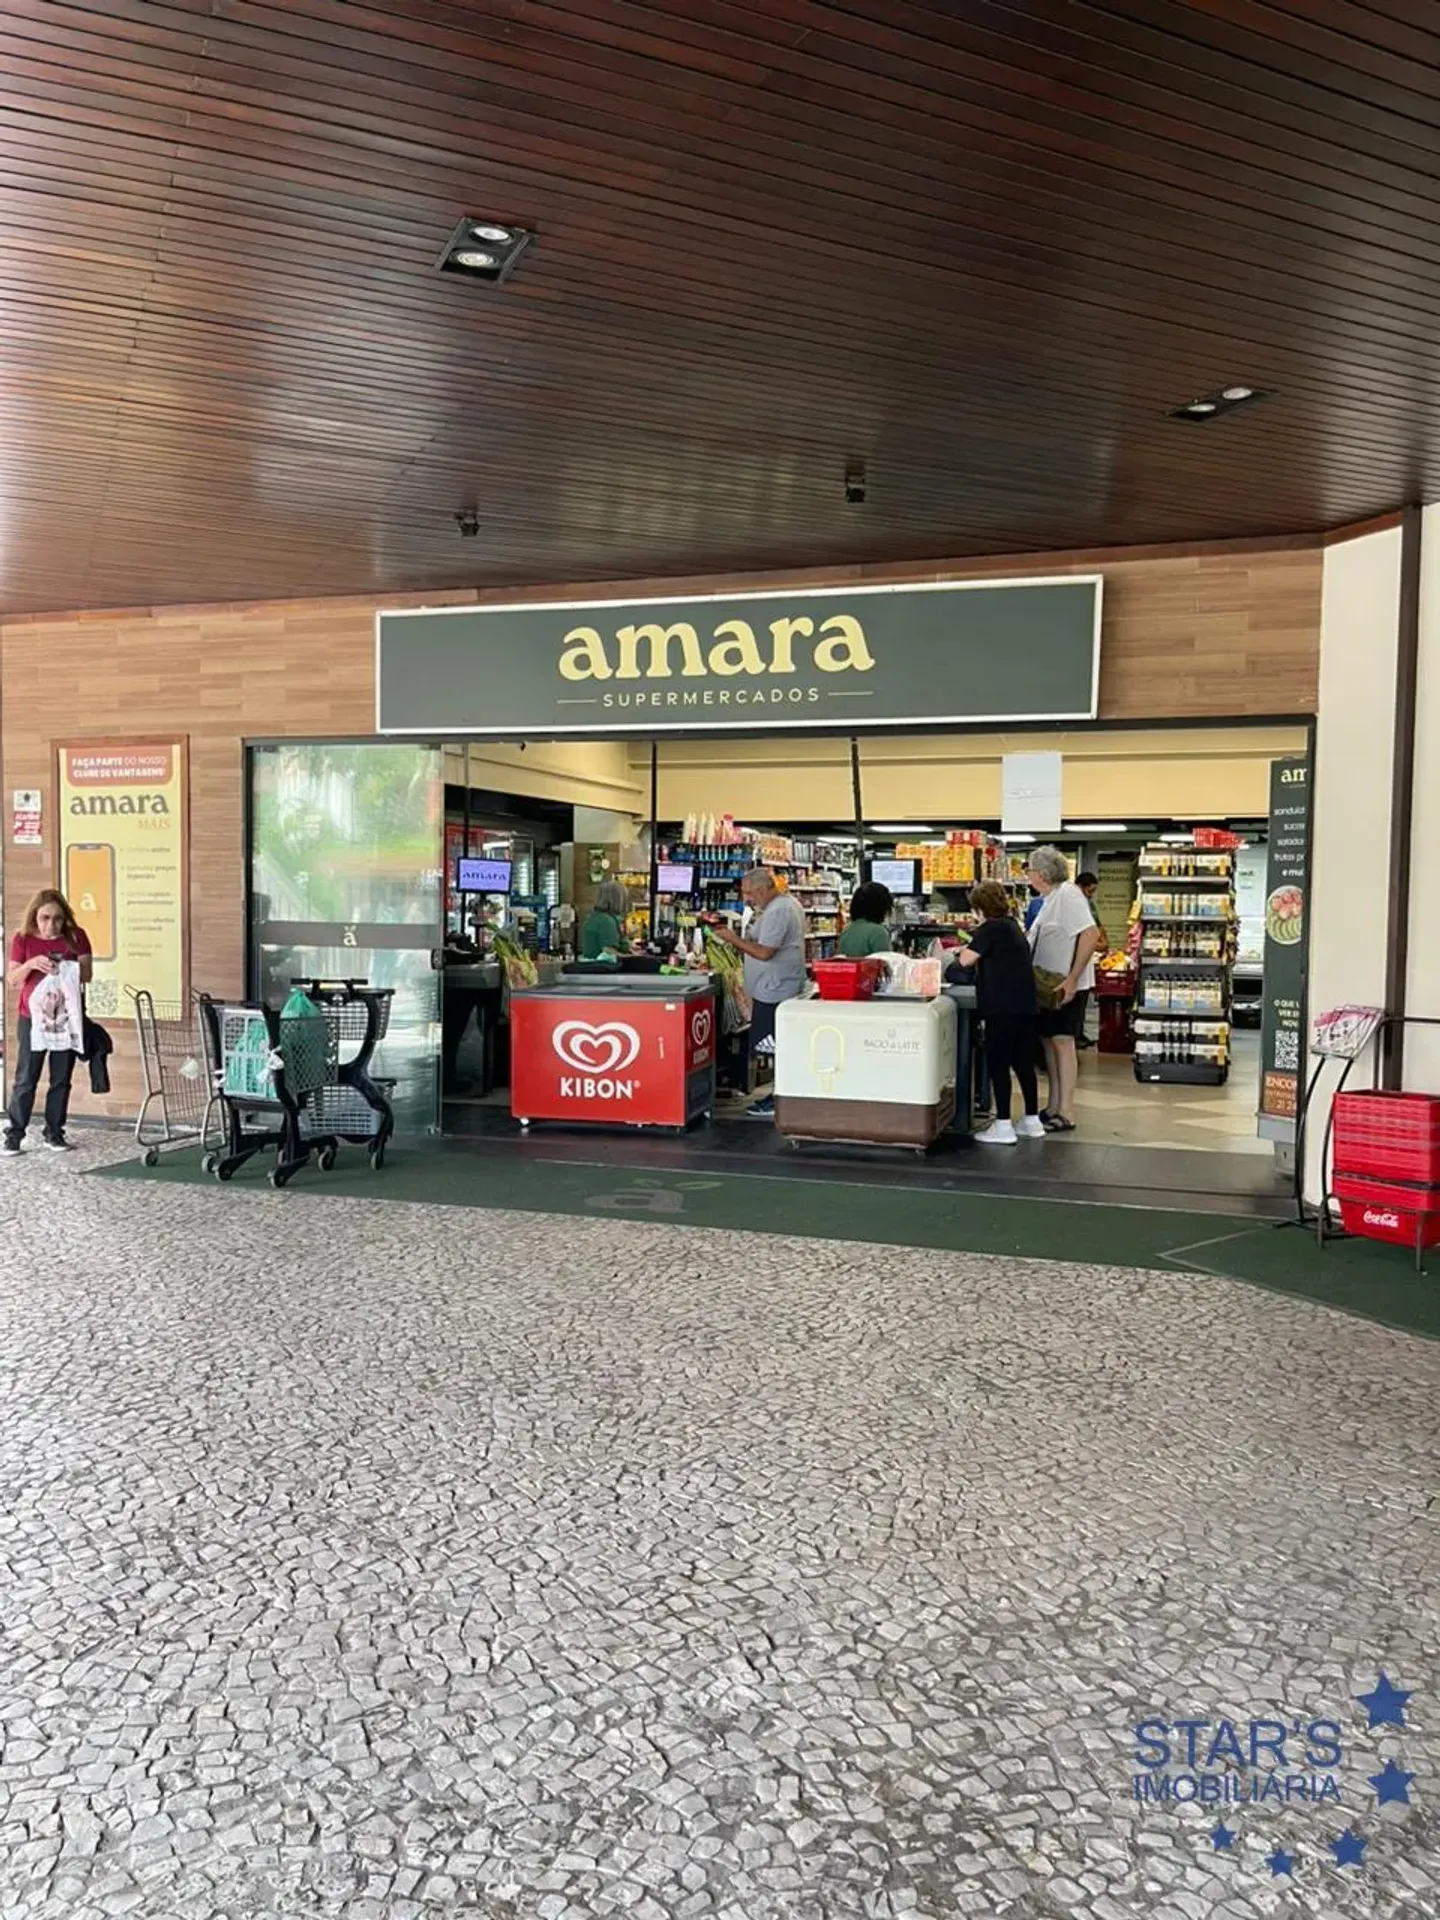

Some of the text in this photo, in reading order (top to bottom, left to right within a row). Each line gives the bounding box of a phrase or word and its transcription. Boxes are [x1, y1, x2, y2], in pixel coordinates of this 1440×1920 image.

[559, 614, 875, 681] amara
[602, 687, 820, 708] SUPERMERCADOS
[70, 793, 169, 815] amara
[80, 892, 97, 911] a
[343, 931, 357, 947] a
[560, 1077, 633, 1099] KIBON
